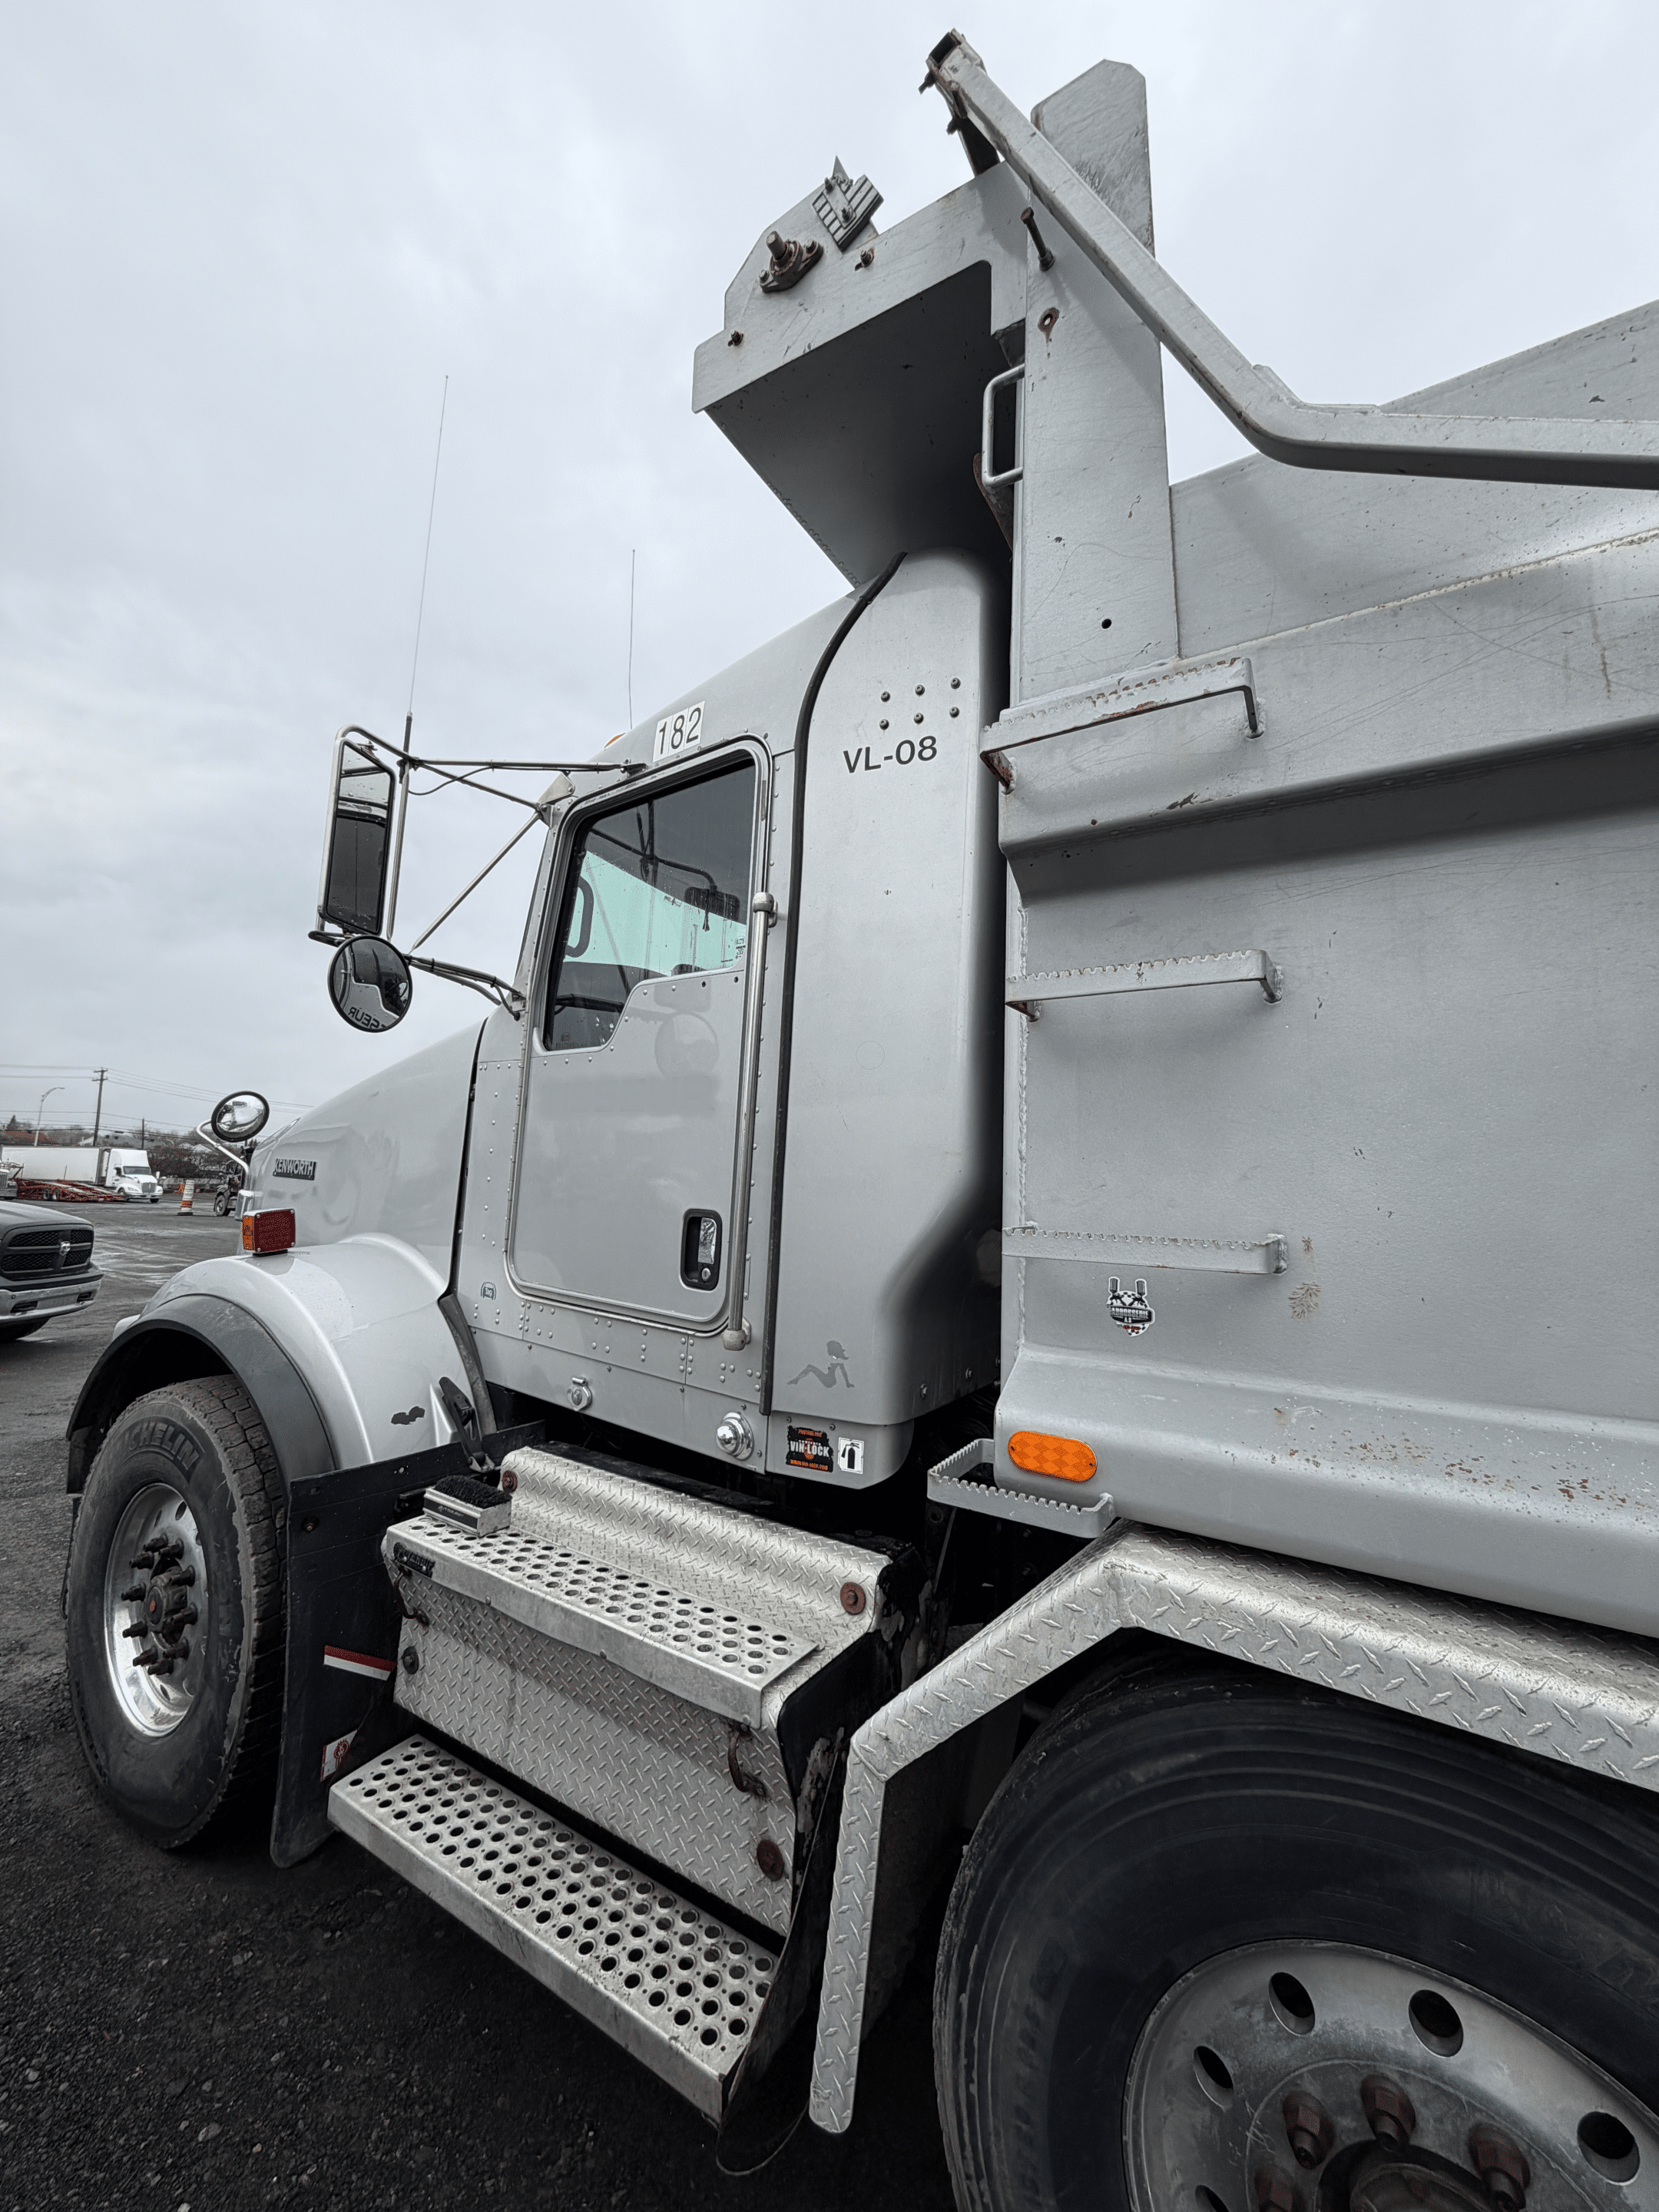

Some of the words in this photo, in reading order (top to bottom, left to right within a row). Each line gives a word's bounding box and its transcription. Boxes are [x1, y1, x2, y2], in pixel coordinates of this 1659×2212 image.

[658, 706, 702, 754] 182
[843, 735, 938, 773] VL-08
[274, 1158, 315, 1176] KENWORTH
